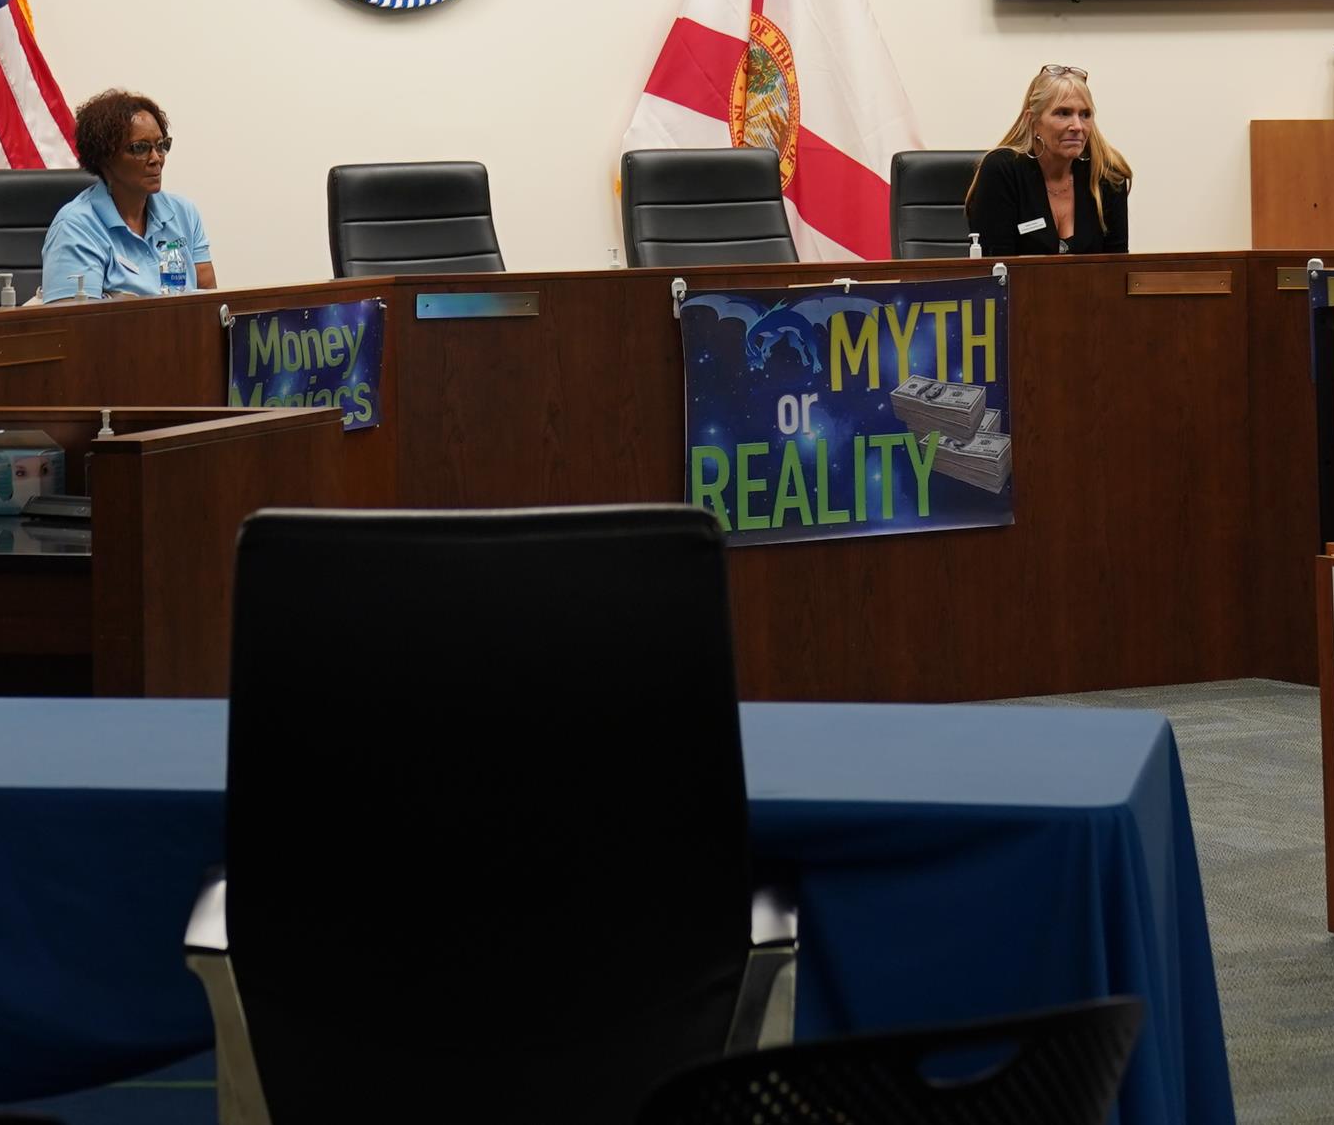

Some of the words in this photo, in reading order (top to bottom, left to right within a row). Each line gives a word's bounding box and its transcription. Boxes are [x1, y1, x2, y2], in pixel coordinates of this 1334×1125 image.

[770, 36, 795, 75] THE
[248, 317, 366, 379] Money
[830, 299, 996, 391] MYTH
[777, 392, 819, 436] or
[691, 431, 940, 532] REALITY
